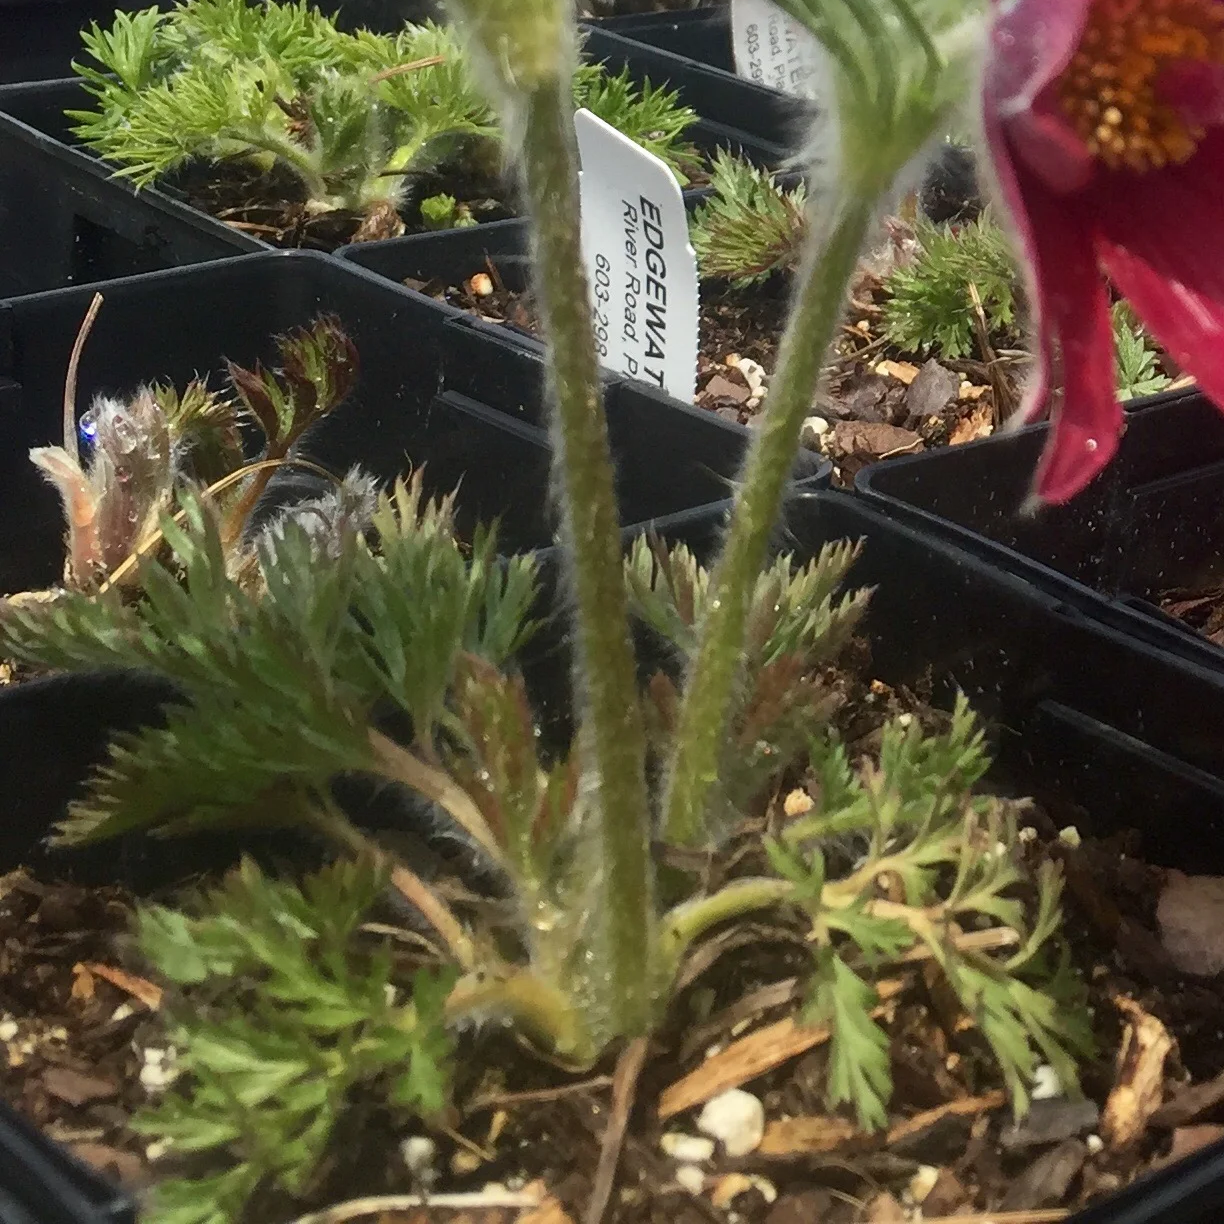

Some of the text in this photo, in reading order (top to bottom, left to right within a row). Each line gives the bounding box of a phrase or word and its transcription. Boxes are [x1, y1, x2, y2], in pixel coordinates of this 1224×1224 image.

[622, 199, 639, 269] River
[621, 271, 641, 343] Road,
[640, 194, 667, 389] EDGEWAT
